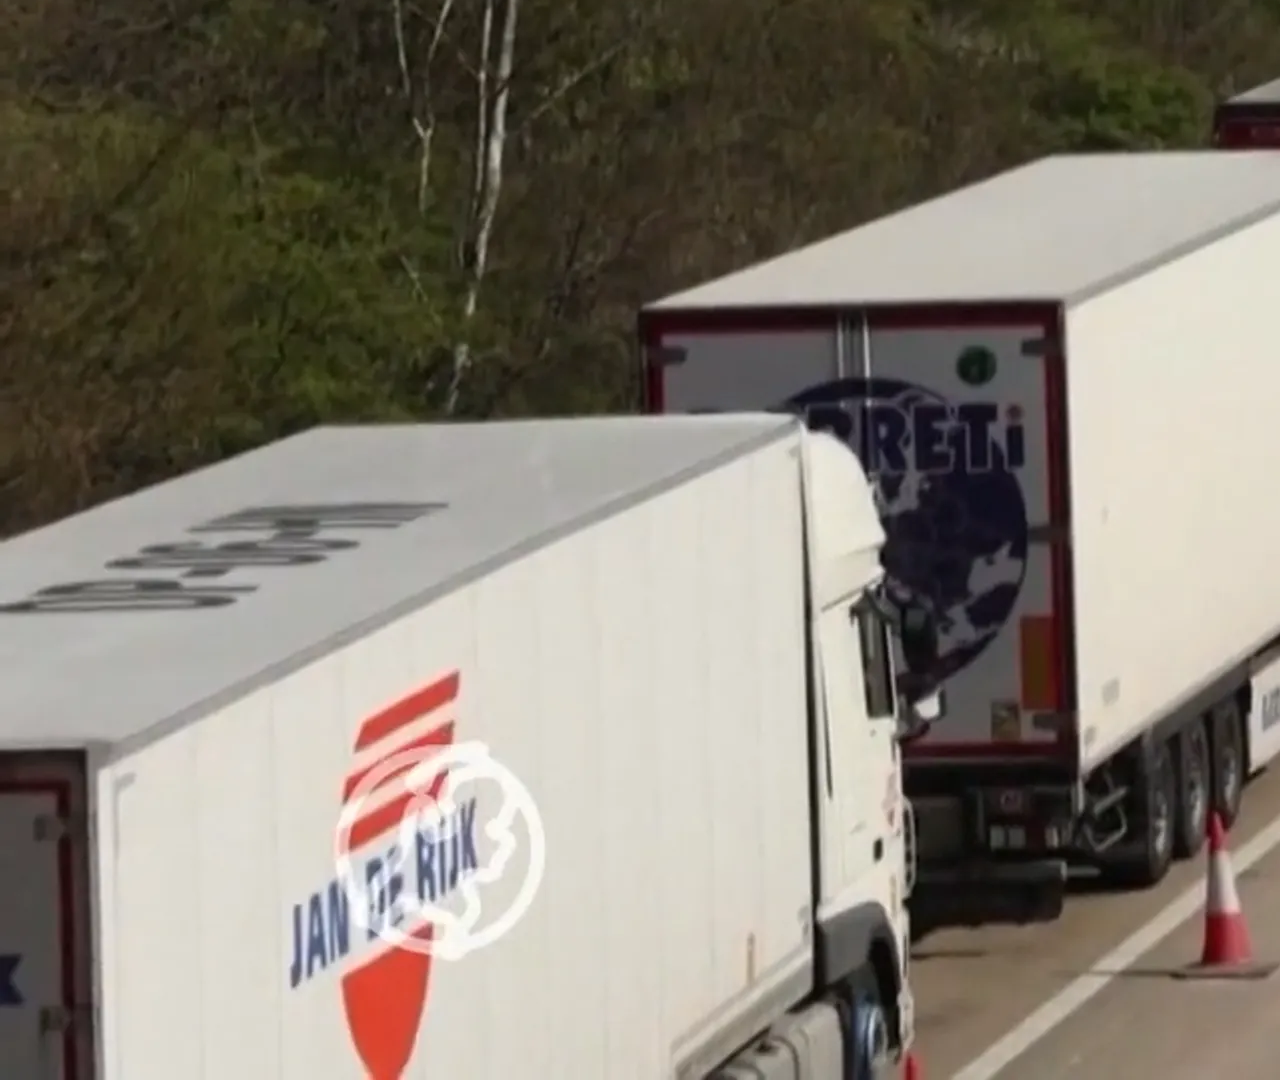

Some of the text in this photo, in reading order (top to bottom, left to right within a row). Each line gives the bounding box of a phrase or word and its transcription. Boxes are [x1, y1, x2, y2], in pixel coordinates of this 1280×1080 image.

[290, 795, 478, 989] JAN DE RIJK
